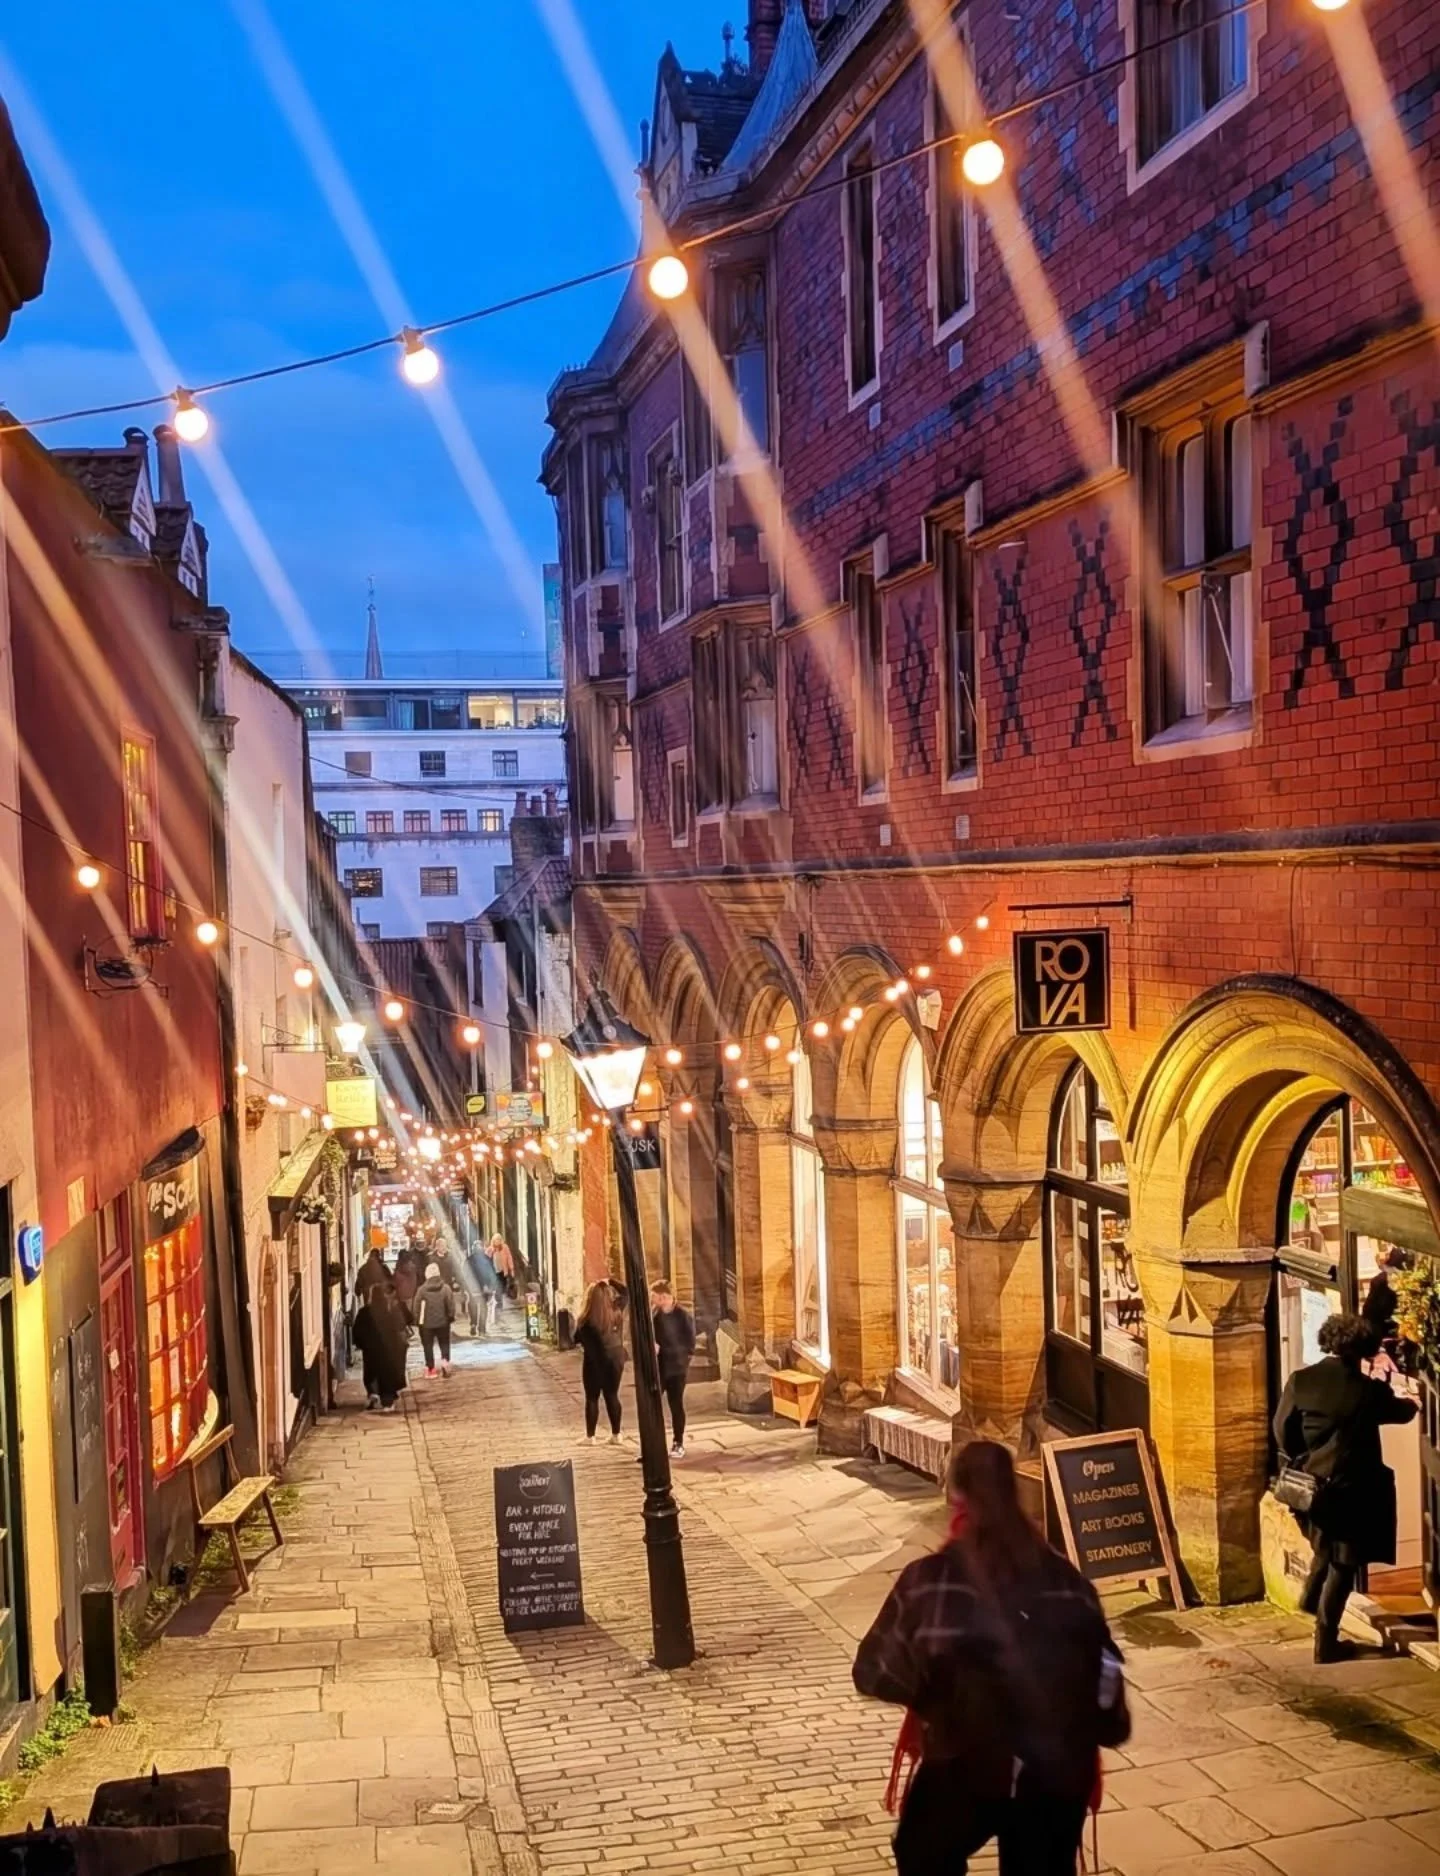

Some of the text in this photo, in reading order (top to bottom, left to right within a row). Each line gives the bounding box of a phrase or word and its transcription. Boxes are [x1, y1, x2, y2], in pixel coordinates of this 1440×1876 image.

[630, 1139, 656, 1152] USK
[526, 1293, 539, 1337] open
[1082, 1460, 1116, 1480] Open
[1072, 1483, 1140, 1505] MAGAZINES
[505, 1506, 522, 1517] BAR
[532, 1504, 567, 1515] KITCHEN
[508, 1521, 534, 1533] EVENT
[1081, 1512, 1145, 1533] ART BOOKS
[1086, 1541, 1152, 1562] STATIONERY
[557, 1601, 579, 1612] NEXT
